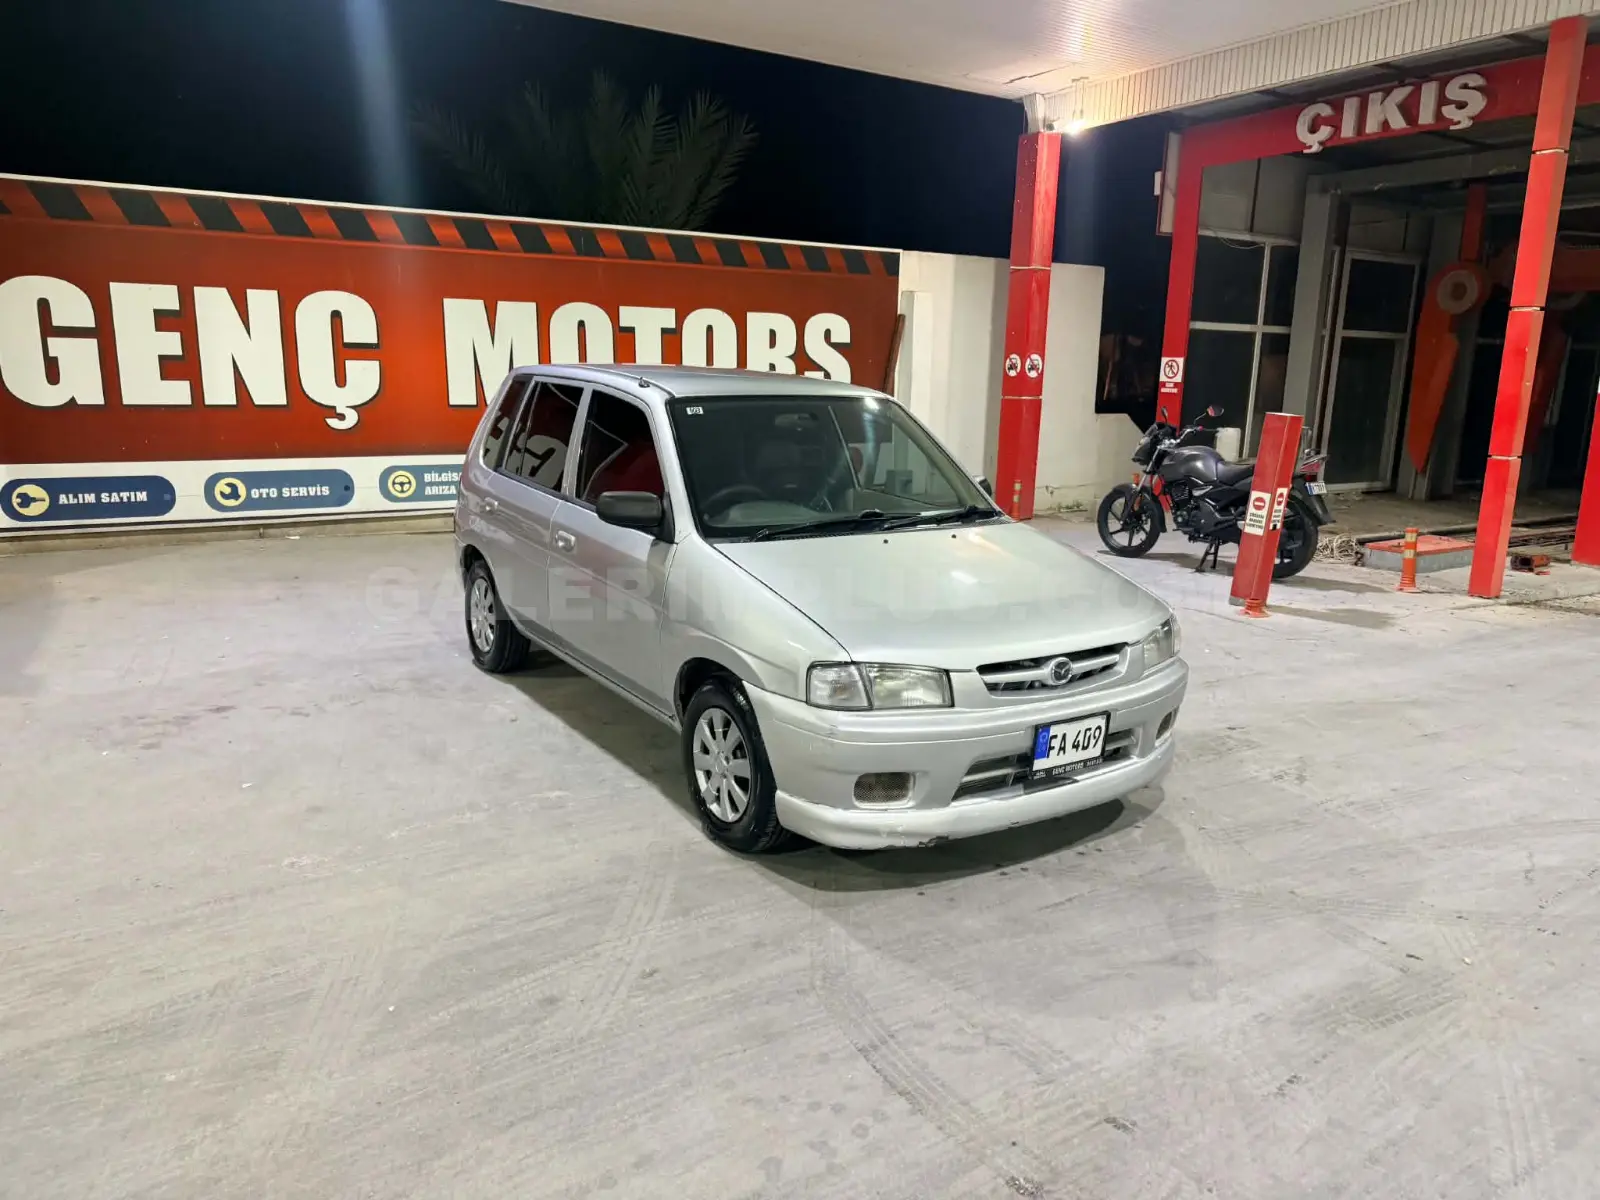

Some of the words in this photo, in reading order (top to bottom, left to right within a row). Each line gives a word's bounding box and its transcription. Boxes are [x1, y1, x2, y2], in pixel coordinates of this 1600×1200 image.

[1296, 72, 1488, 153] ÇIKIŞ
[0, 275, 381, 430] GENÇ
[442, 298, 851, 406] MOTORS
[424, 471, 462, 482] BİLGİS
[58, 492, 96, 505] ALIM
[101, 490, 148, 504] SATIM
[251, 486, 277, 498] OTO
[282, 484, 330, 497] SERVİS
[425, 485, 457, 495] ARIZA
[1047, 732, 1067, 759] FA
